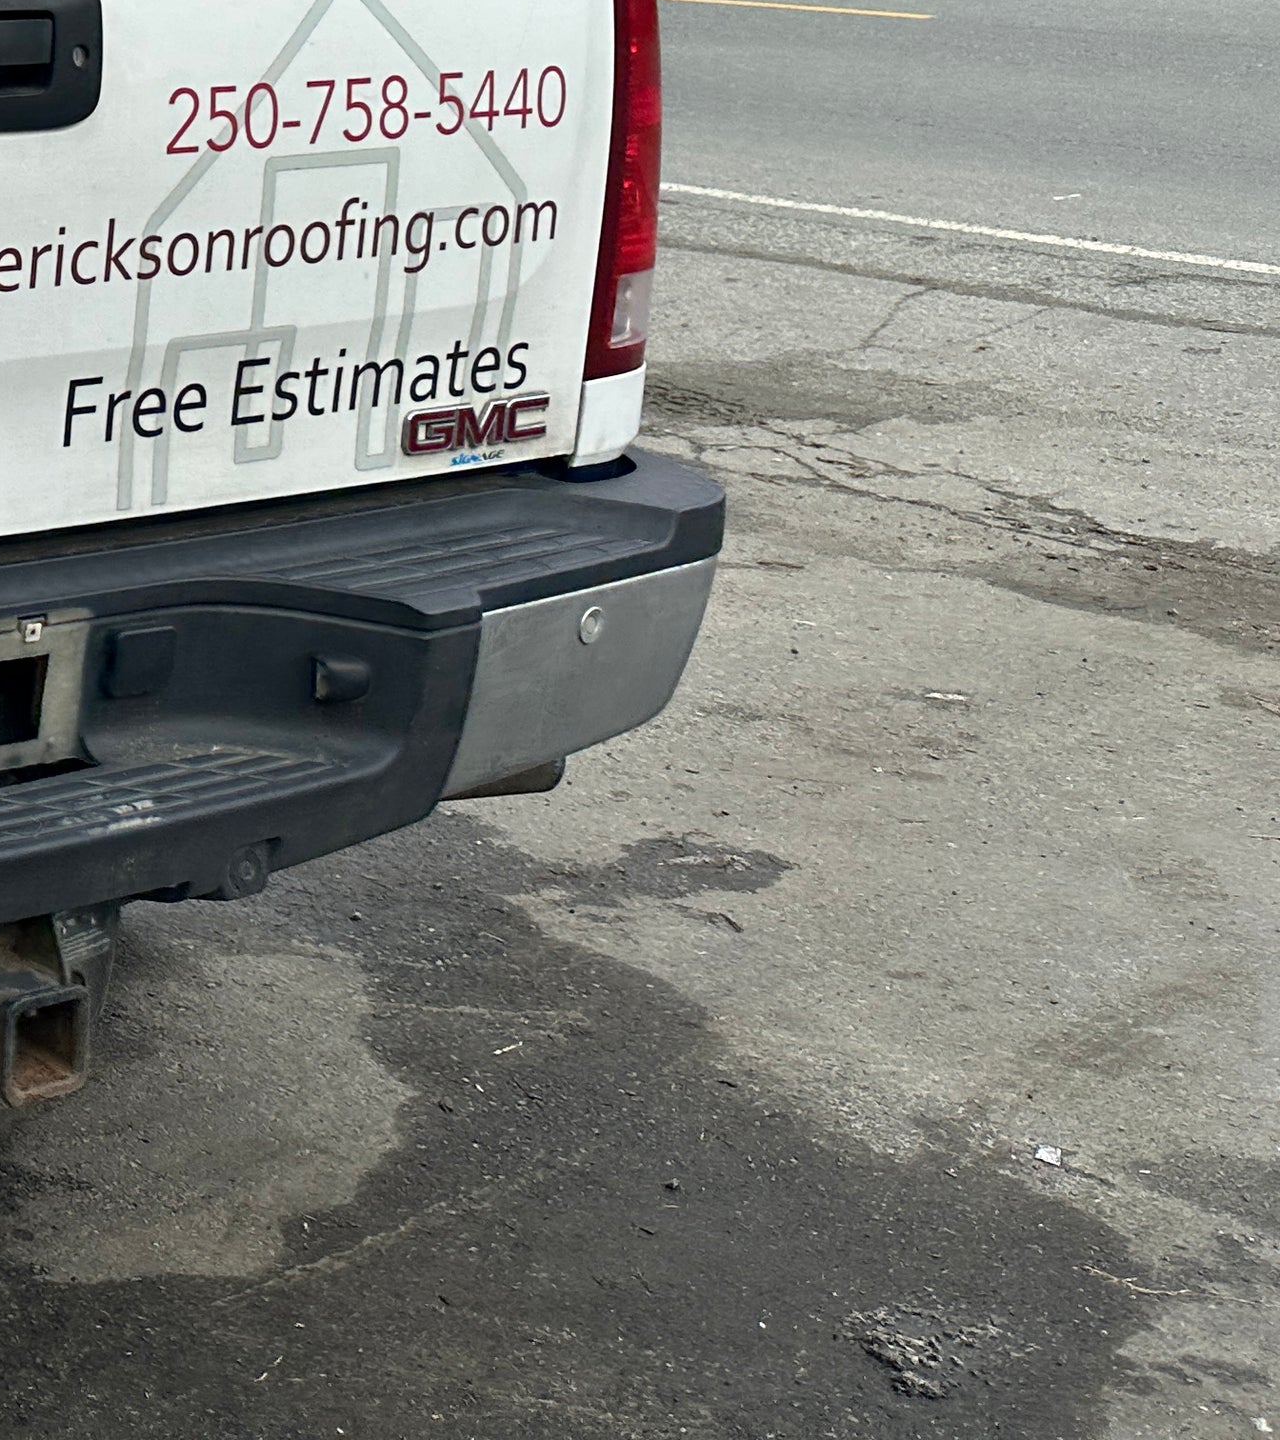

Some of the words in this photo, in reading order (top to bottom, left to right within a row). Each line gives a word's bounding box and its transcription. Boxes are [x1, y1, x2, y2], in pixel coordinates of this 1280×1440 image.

[165, 65, 567, 156] 250-758-5440
[62, 376, 208, 447] Free
[230, 339, 530, 427] Estimates
[401, 391, 551, 456] GMC
